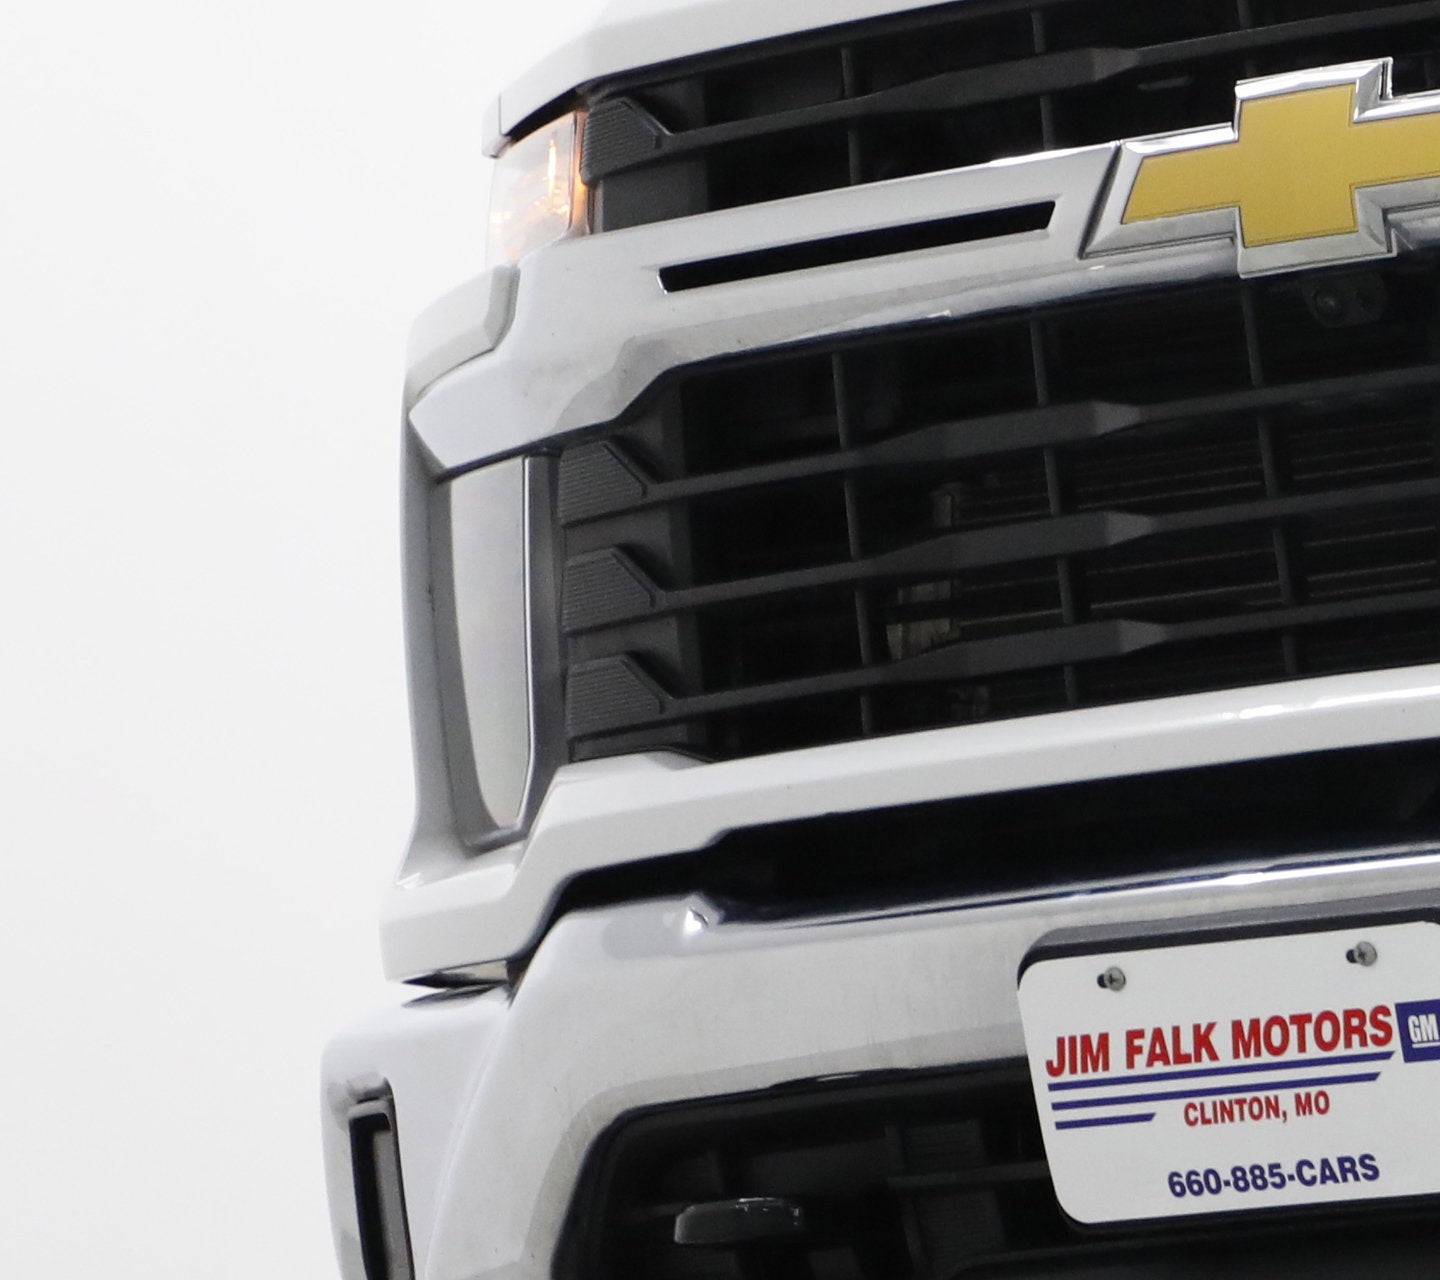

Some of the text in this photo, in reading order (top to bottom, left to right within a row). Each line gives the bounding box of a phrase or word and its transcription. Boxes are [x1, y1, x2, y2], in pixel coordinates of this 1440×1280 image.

[1045, 1004, 1394, 1078] JIM FALK MOTORS
[1407, 1012, 1440, 1044] GM
[1183, 1089, 1331, 1128] CLINTON, MO
[1167, 1153, 1380, 1199] 660-885-CARS
